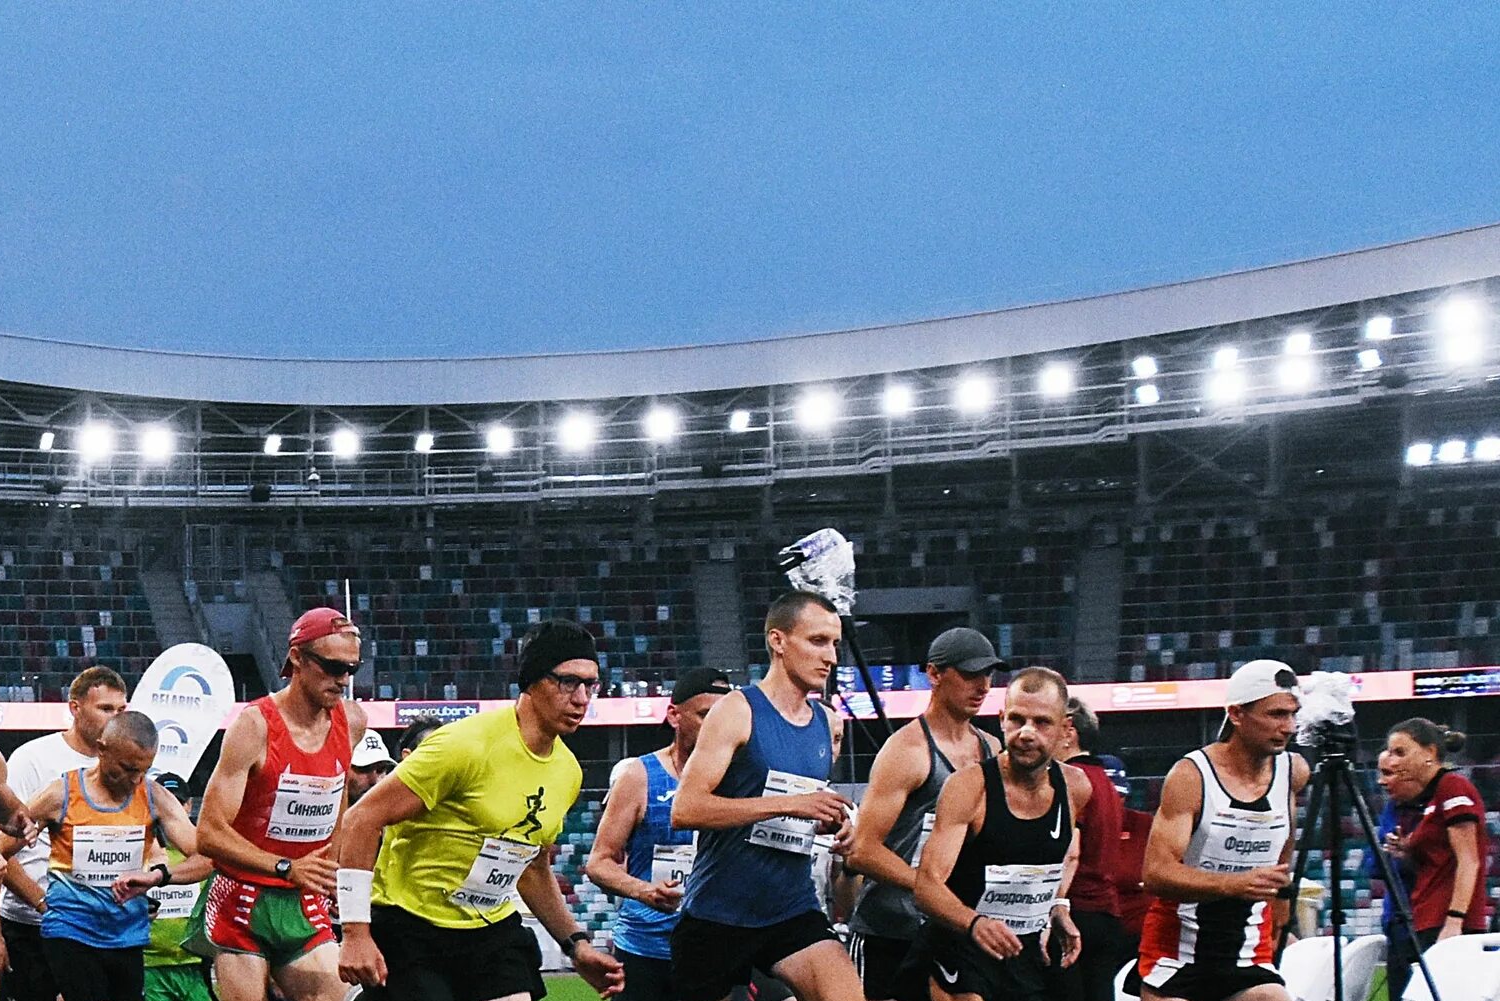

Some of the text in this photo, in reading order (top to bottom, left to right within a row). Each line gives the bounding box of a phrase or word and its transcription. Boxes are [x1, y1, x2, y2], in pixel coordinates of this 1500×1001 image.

[152, 692, 201, 706] BELARUS
[287, 800, 334, 817] Синяков
[285, 827, 317, 837] BELARUS
[770, 831, 803, 846] BELARUS
[1224, 836, 1272, 855] Федяев
[87, 849, 131, 865] Андрон
